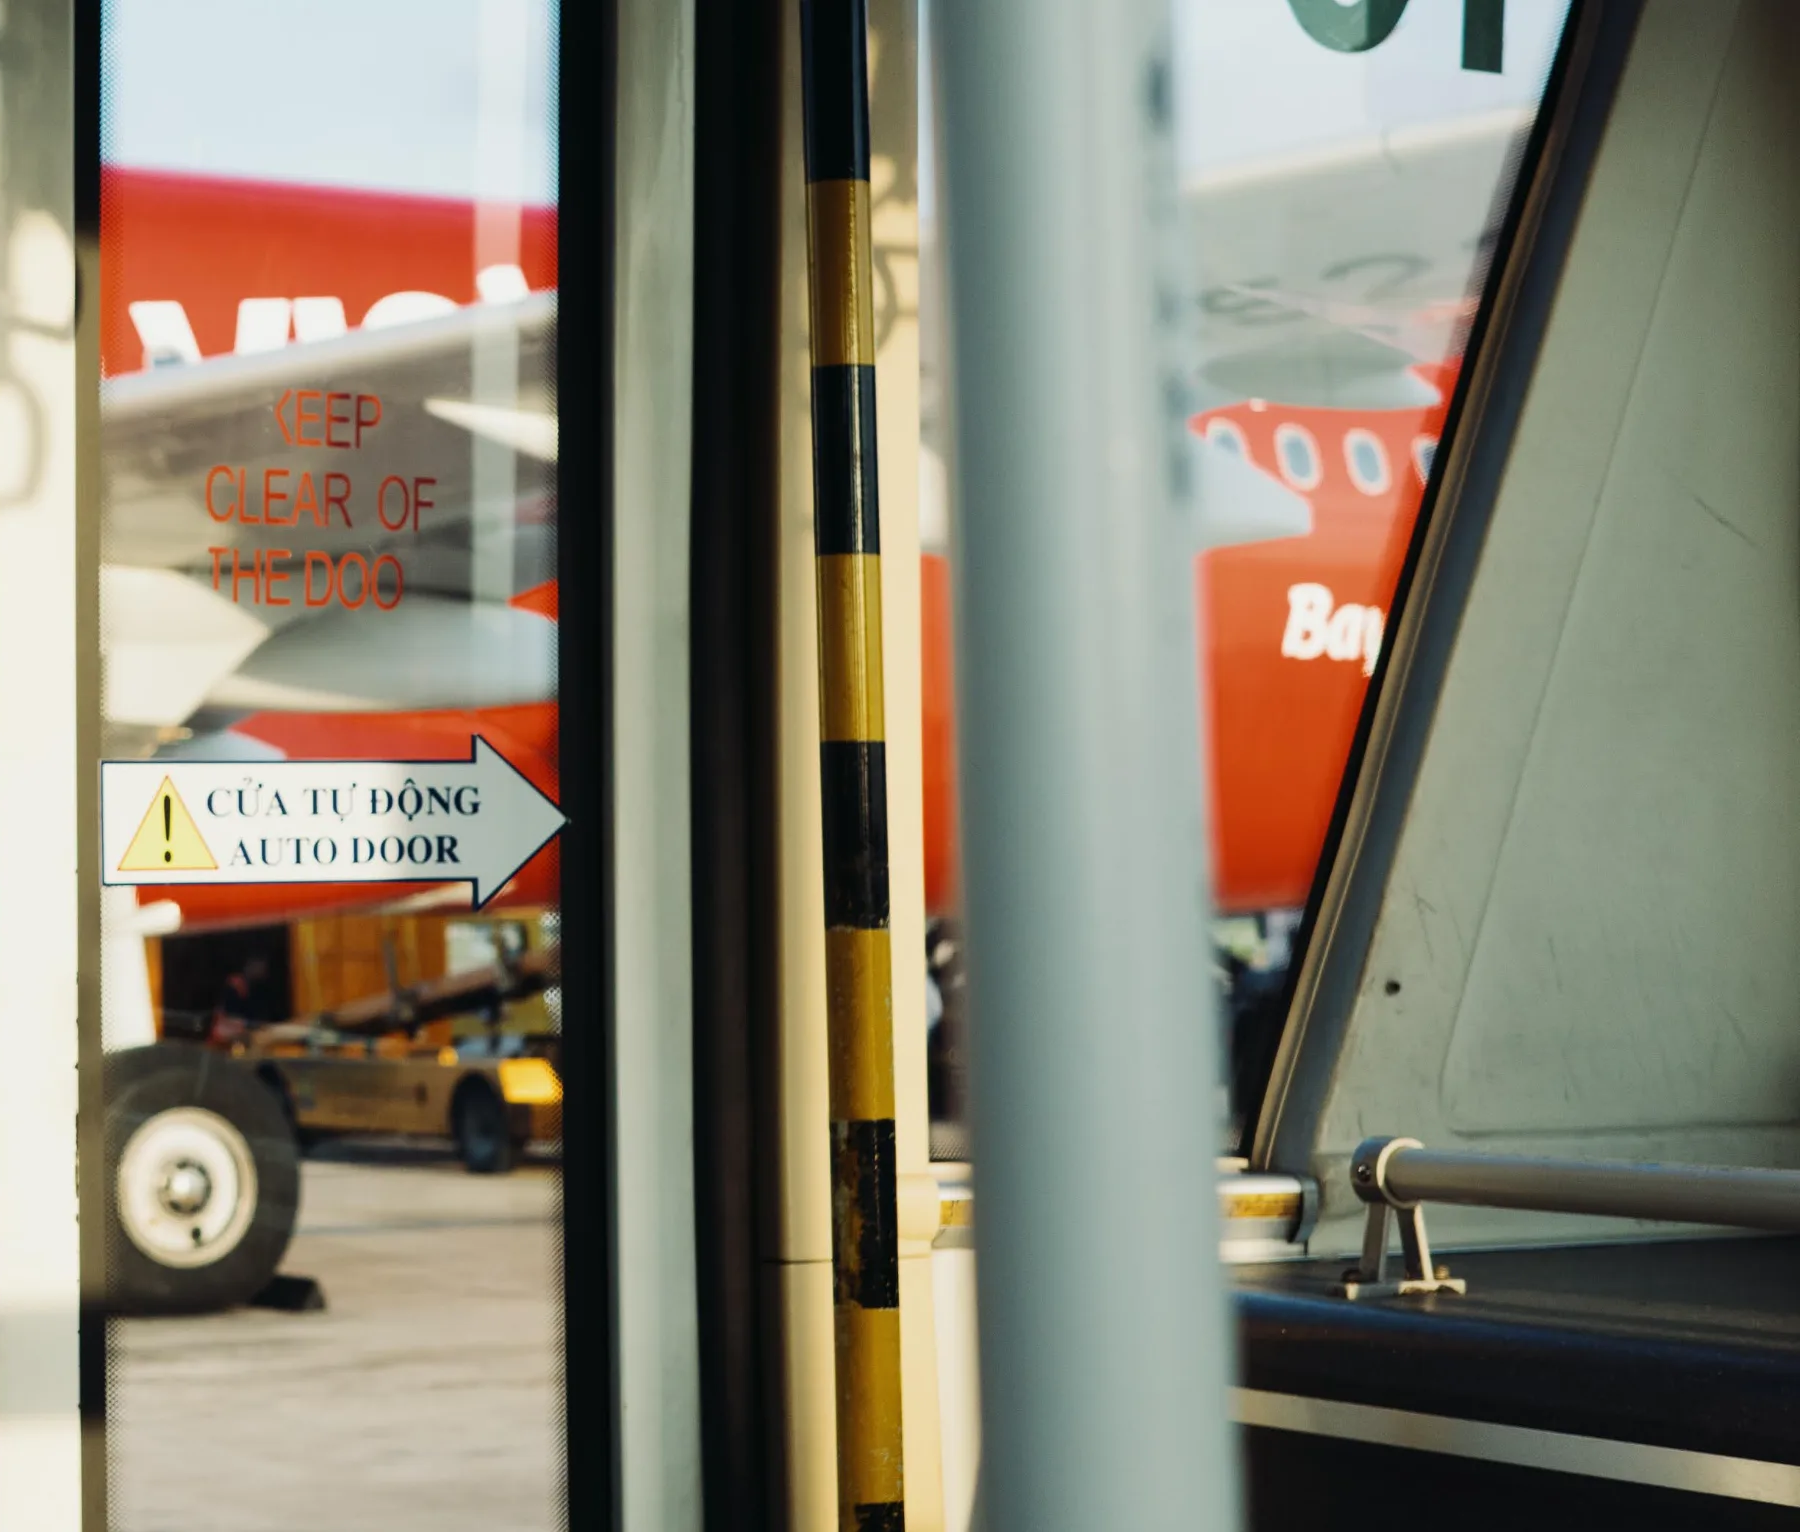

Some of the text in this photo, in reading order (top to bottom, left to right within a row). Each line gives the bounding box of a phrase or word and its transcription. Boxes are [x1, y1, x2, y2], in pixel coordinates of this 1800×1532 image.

[205, 465, 437, 532] CLEAR OF
[208, 546, 292, 606] THE
[207, 777, 481, 822] CỬA TỰ ĐỘNG
[229, 835, 460, 865] AUTO DOOR
